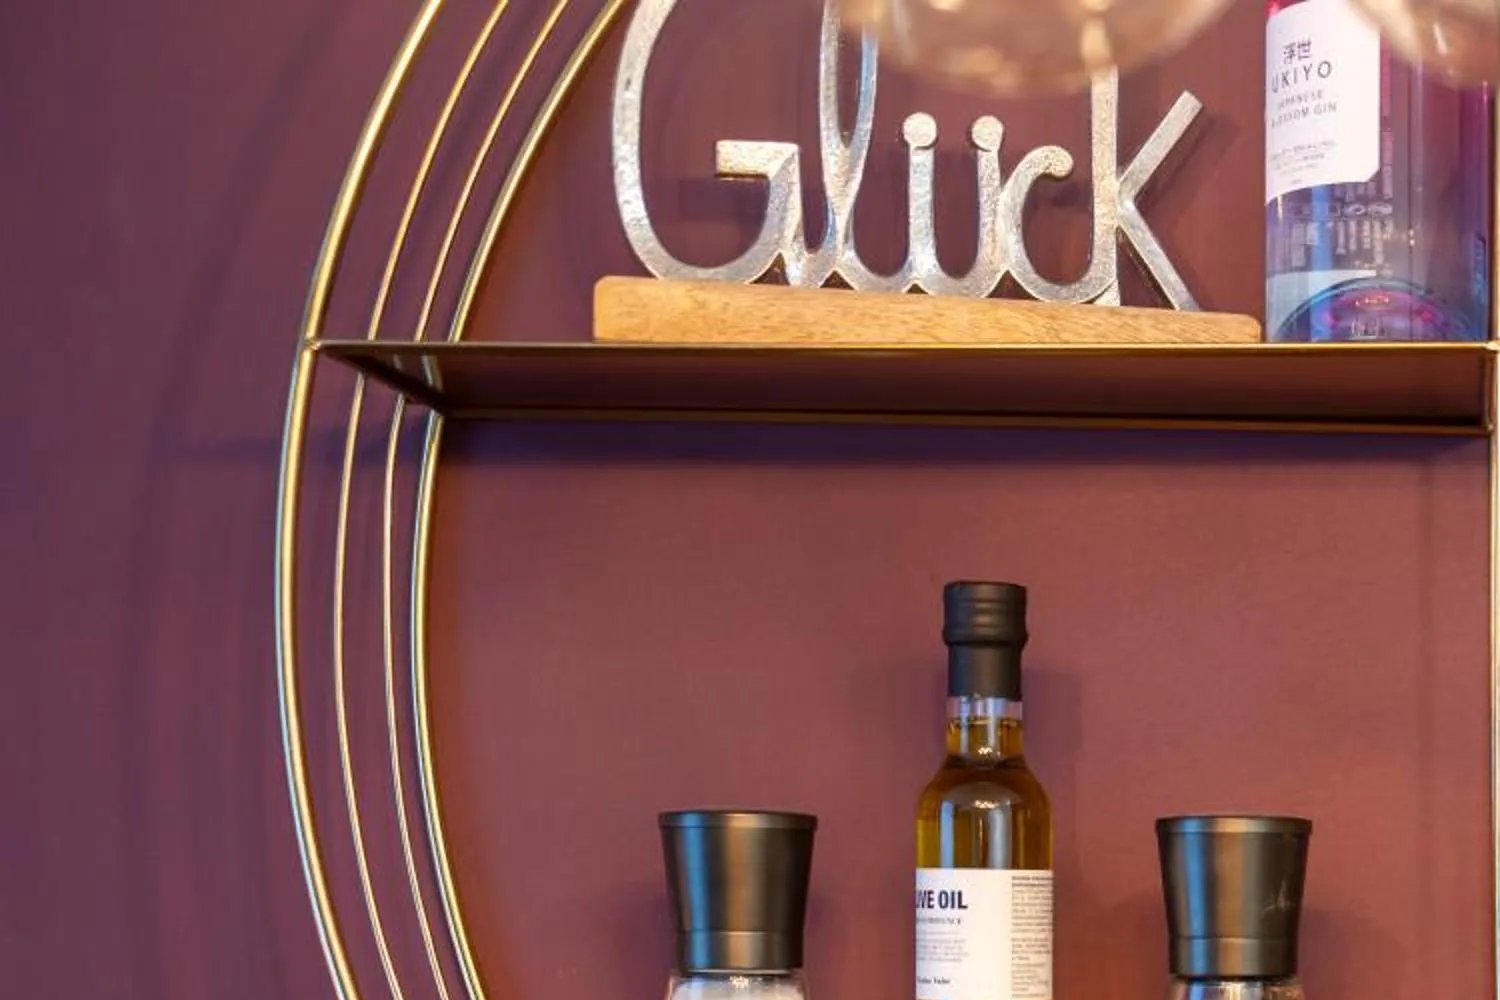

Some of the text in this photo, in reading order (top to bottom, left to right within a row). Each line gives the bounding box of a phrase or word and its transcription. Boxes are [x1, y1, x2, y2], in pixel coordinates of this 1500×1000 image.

[1271, 61, 1332, 93] UKIYO
[1313, 101, 1338, 115] GIN
[612, 0, 1203, 311] Glück
[938, 889, 969, 910] OIL
